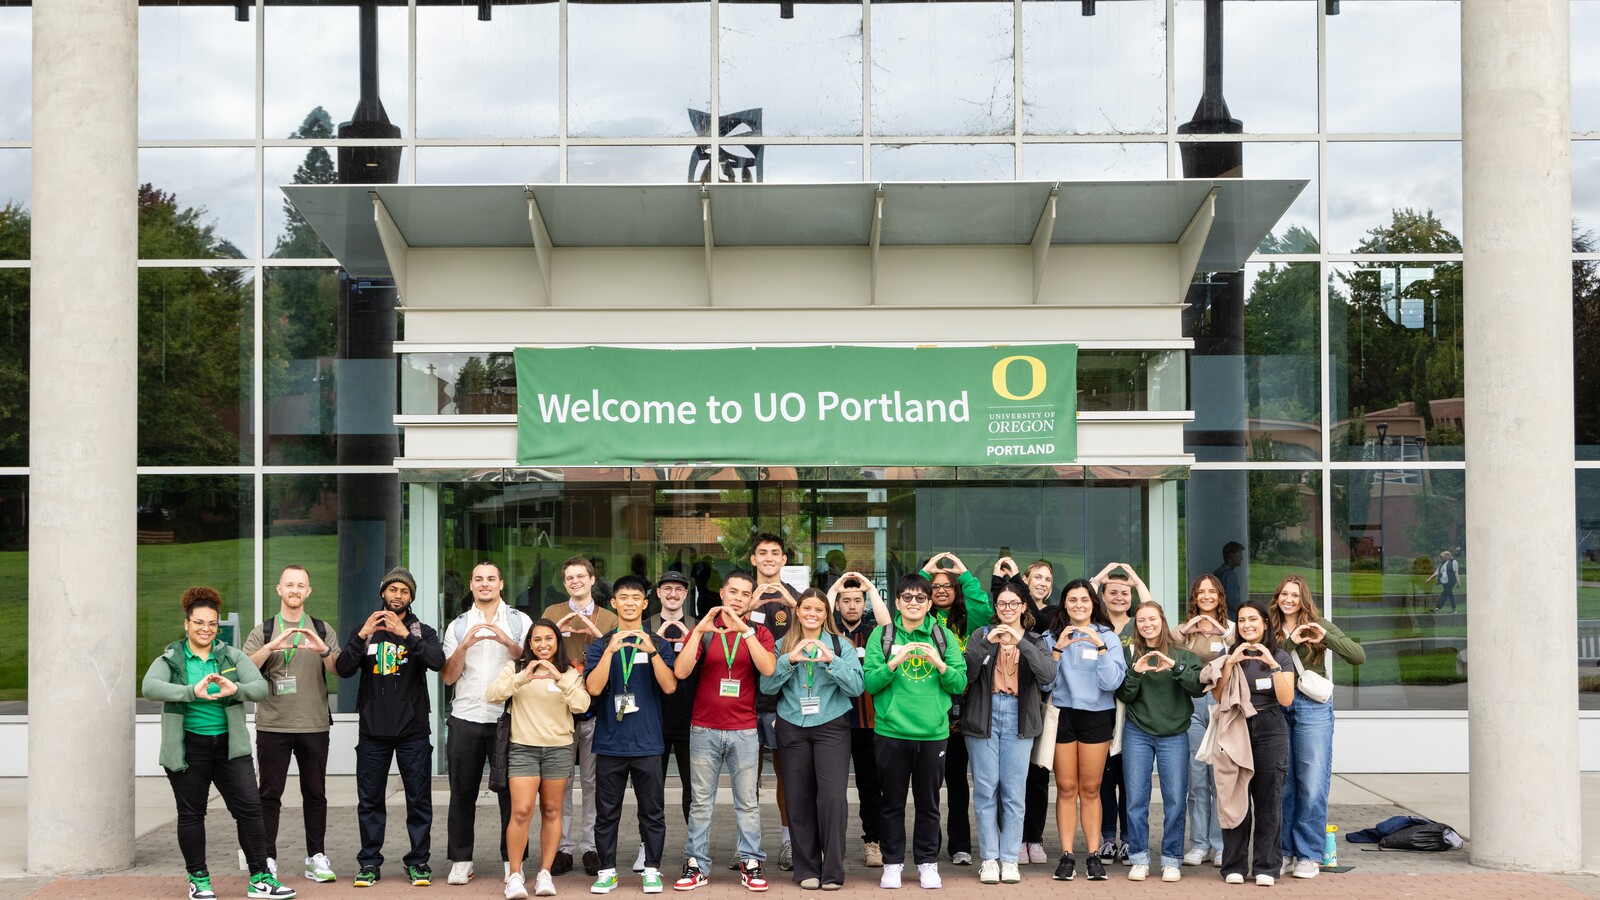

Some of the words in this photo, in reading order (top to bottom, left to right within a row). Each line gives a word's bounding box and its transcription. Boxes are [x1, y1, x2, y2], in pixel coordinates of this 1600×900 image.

[992, 355, 1047, 401] O
[537, 388, 697, 425] Welcome
[705, 395, 743, 425] to
[753, 391, 807, 424] UO
[817, 390, 971, 424] Portland
[989, 412, 1042, 420] UNIVERSITY
[988, 419, 1055, 433] OREGON
[986, 443, 1055, 456] PORTLAND
